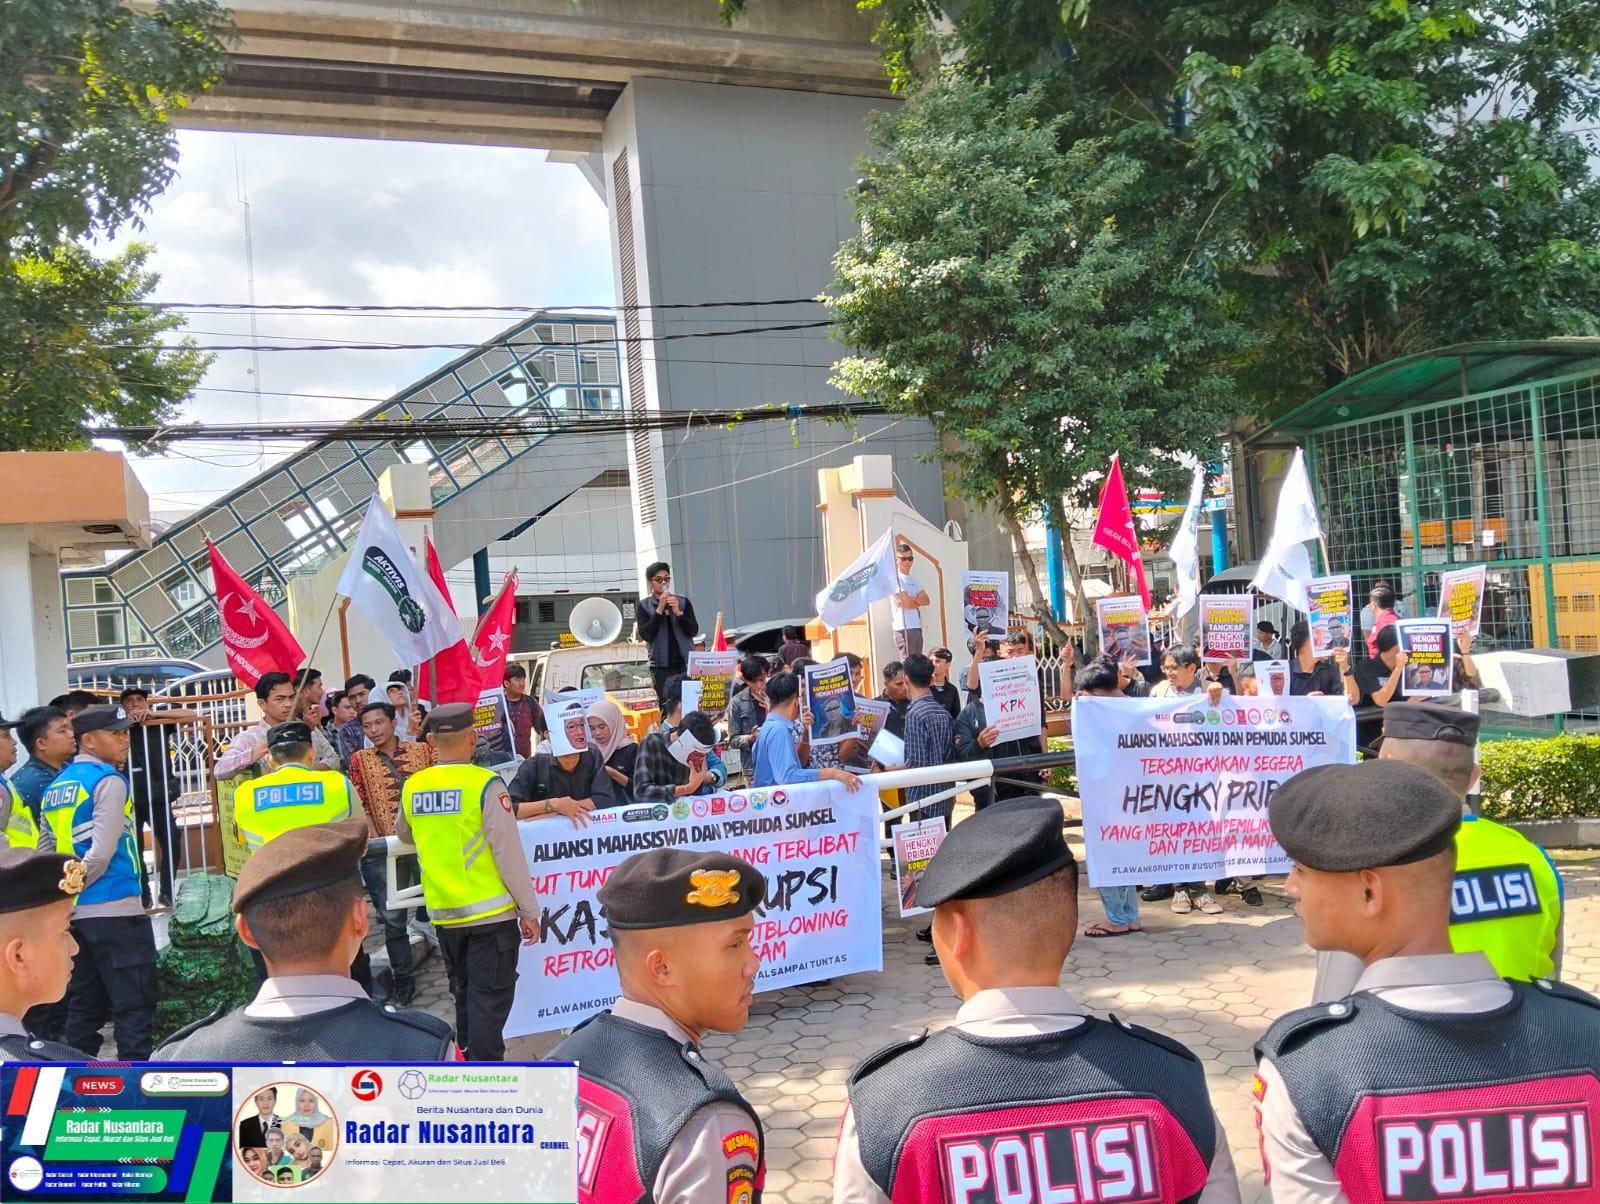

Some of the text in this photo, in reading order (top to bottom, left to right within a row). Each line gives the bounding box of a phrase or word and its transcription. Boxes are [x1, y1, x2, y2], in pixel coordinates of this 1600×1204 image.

[373, 555, 405, 589] AKTIVIS
[1208, 632, 1245, 641] HENGKY
[1209, 641, 1244, 649] PRIBADI
[1412, 634, 1440, 643] HENGKY
[1412, 643, 1440, 651] PRIBADI
[1000, 697, 1026, 712] KPK
[1118, 731, 1327, 749] ALIANSI MAHASISWA DAN PEMUDA SUMSEL
[1141, 755, 1304, 776] TERSANGKAKAN SEGERA
[45, 786, 78, 808] POLISI
[257, 784, 321, 808] POLISI
[412, 791, 461, 814] POLISI
[1122, 781, 1222, 815] HENGKY
[592, 812, 617, 823] MAKI
[533, 808, 836, 863] ALIANSI MAHASISWA DAN PEMUDA SUMSEL
[1100, 817, 1270, 842] YANG MERUPAKAN PEMILIK
[774, 832, 860, 863] TERLIBAT
[905, 837, 937, 851] HENGKY
[1149, 838, 1179, 856] DAN
[1237, 854, 1294, 867] #KAWALSAMP
[1452, 872, 1538, 916] OLISI
[810, 954, 847, 969] TUNTAS
[949, 1124, 1153, 1204] POLISI
[1384, 1111, 1588, 1197] POLISI
